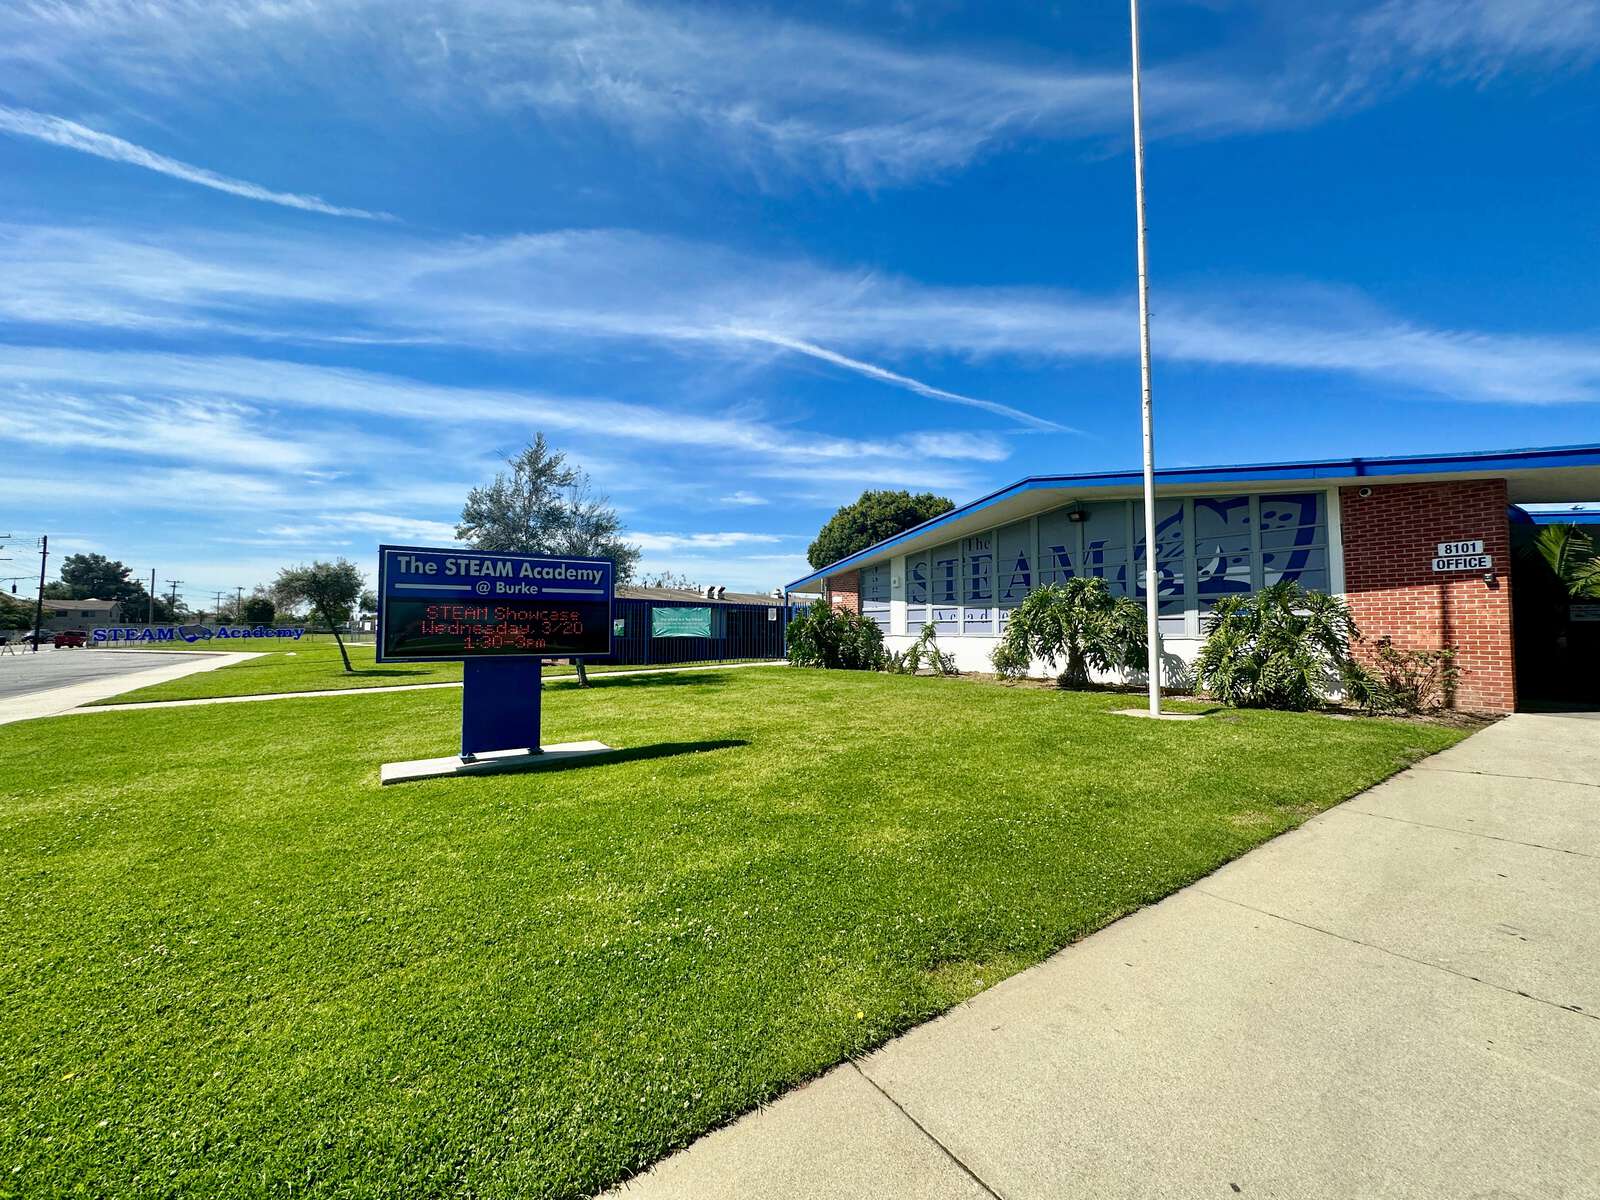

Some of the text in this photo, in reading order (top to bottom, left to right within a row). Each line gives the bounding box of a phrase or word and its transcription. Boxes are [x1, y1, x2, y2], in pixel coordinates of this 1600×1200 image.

[967, 537, 991, 551] The
[1444, 542, 1477, 555] 8101
[397, 556, 603, 585] The STEAM Academy
[1436, 556, 1487, 570] OFFICE
[911, 540, 1110, 603] STEAM
[476, 580, 539, 595] @ Burke
[425, 605, 581, 621] STEAM Showcase
[93, 625, 305, 642] STEAM Academy
[541, 621, 583, 635] 3/20
